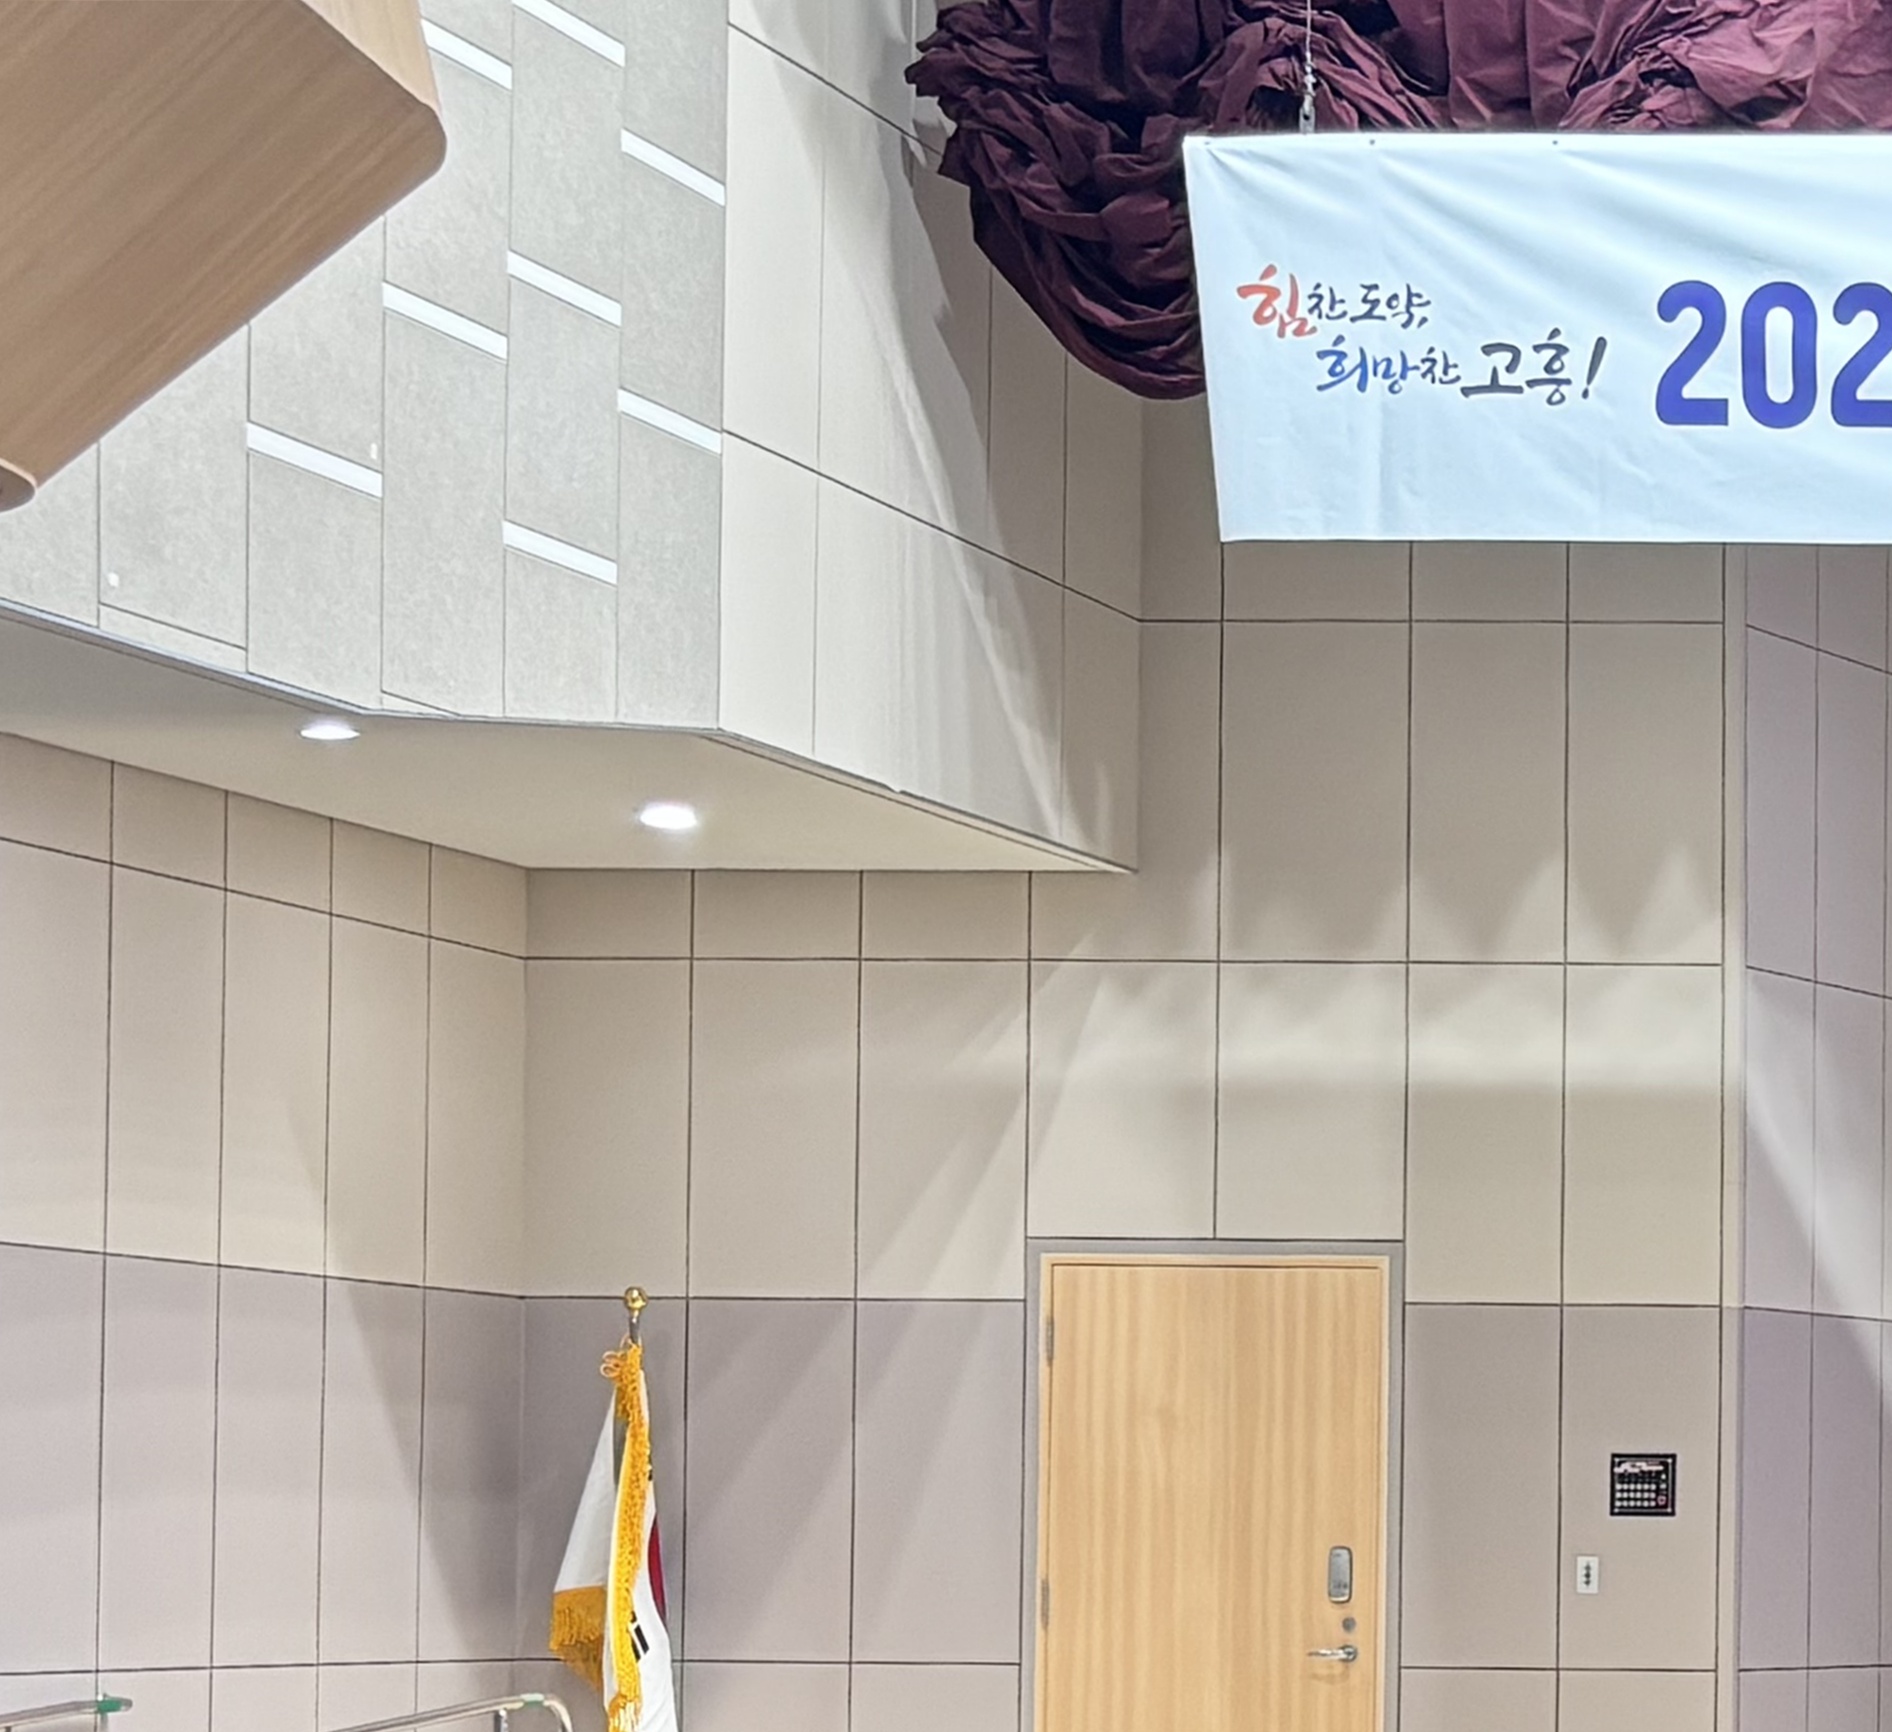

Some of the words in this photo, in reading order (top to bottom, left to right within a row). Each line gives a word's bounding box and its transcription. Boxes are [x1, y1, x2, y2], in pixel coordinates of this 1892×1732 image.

[1237, 264, 1348, 339] 힘찬
[1315, 334, 1462, 395] 희망찬
[1459, 327, 1608, 406] 고흥!
